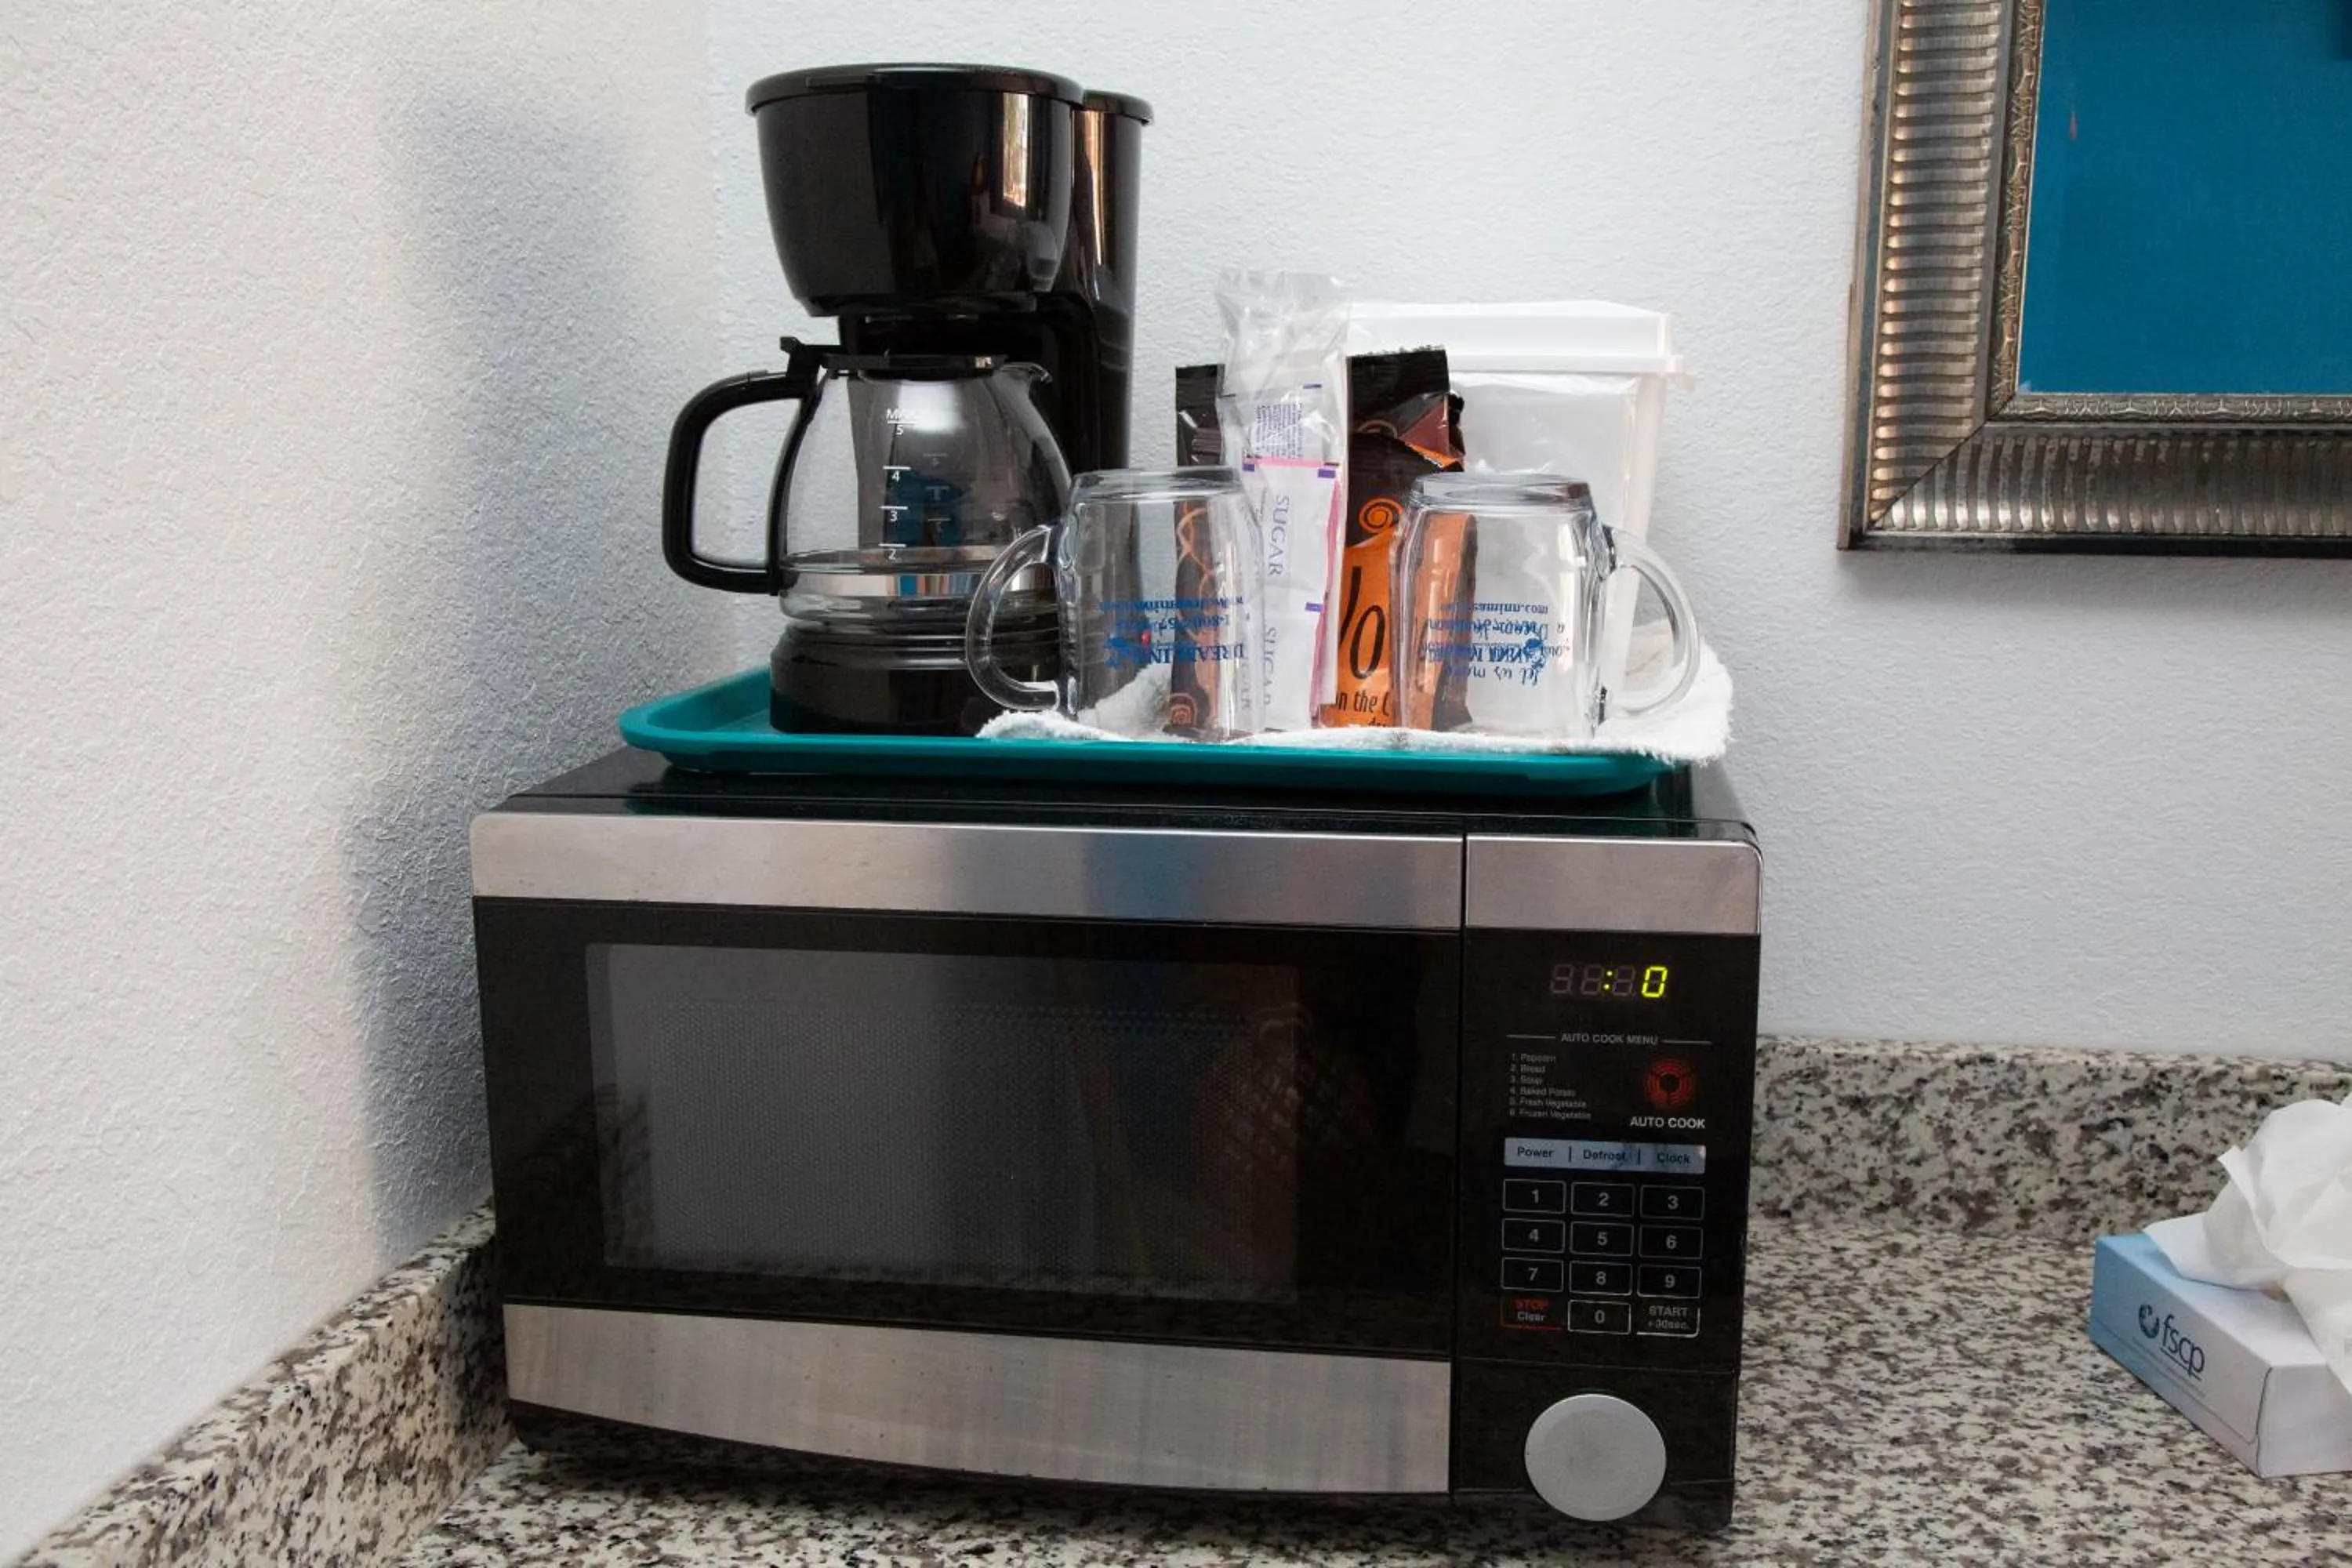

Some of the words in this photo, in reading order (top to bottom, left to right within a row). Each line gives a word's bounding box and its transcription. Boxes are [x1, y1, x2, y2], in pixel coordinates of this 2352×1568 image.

[895, 425, 904, 436] 5
[891, 470, 901, 481] 4
[890, 511, 898, 521] 3
[1267, 495, 1290, 576] SUGAR
[888, 550, 897, 560] 2
[1353, 689, 1378, 713] the
[1561, 1033, 1590, 1043] AUTO
[1592, 1034, 1624, 1044] COOK
[1627, 1036, 1658, 1046] MENU
[1630, 1116, 1664, 1128] AUTO
[1668, 1117, 1706, 1129] COOK
[1516, 1145, 1555, 1159] Power
[1582, 1148, 1627, 1161] Defrost
[1657, 1151, 1691, 1164] Clock
[1531, 1189, 1540, 1203] 1
[1598, 1192, 1610, 1207] 2
[1668, 1196, 1679, 1210] 3
[1529, 1229, 1540, 1243] 4
[1597, 1232, 1607, 1246] 5
[1666, 1235, 1678, 1249] 6
[1528, 1267, 1539, 1282] 7
[1595, 1270, 1606, 1285] 8
[1664, 1274, 1675, 1289] 9
[1515, 1298, 1549, 1310] STOP
[1649, 1305, 1689, 1317] START
[1517, 1311, 1547, 1321] Clear
[1594, 1309, 1605, 1324] 0
